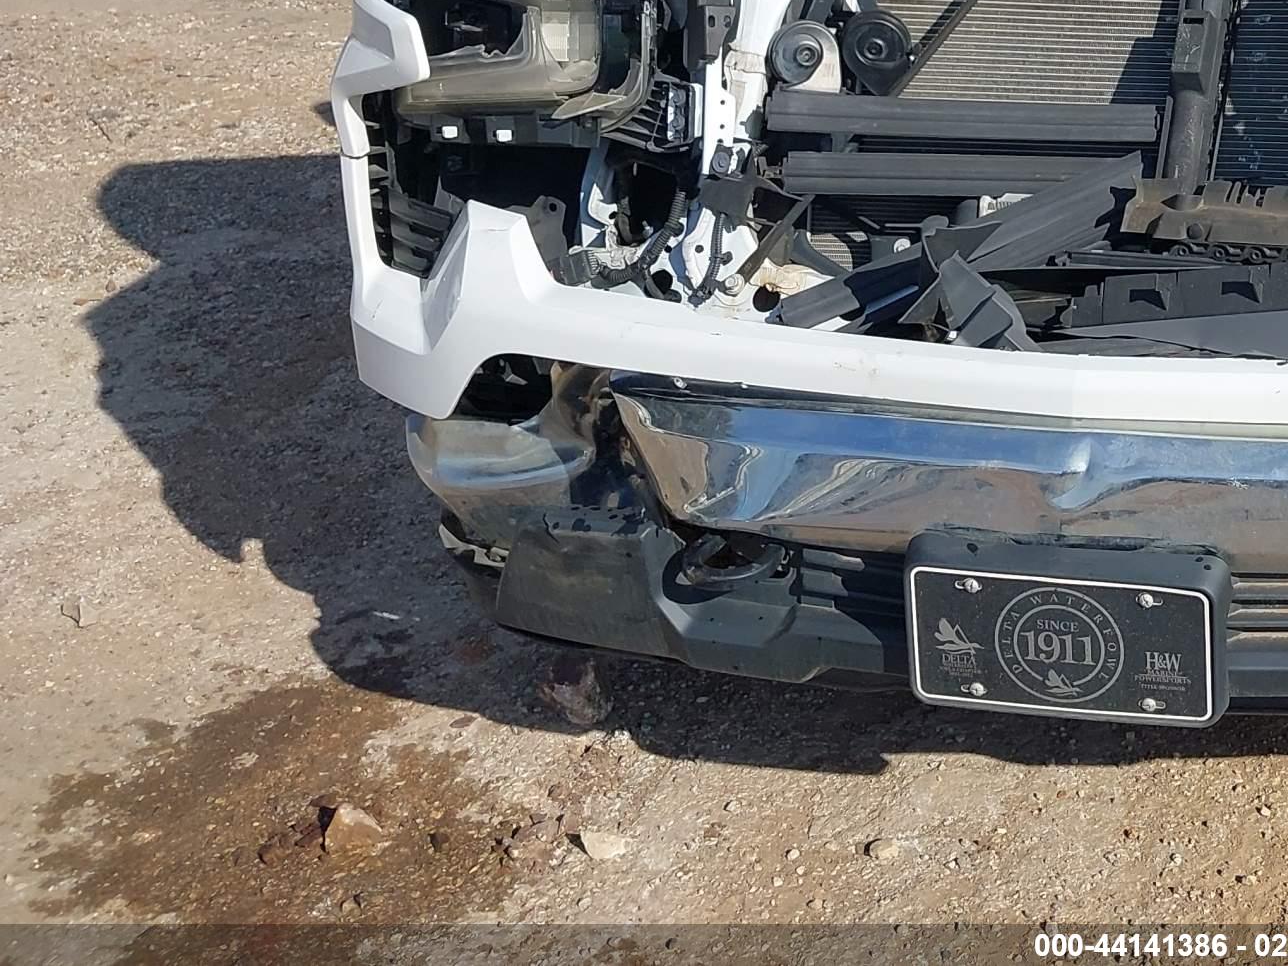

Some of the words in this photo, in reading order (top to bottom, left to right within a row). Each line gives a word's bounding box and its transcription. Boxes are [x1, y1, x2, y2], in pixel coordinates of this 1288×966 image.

[1036, 619, 1079, 632] SINCE
[1002, 611, 1023, 674] DELTA
[1030, 594, 1117, 679] WATERFOWL
[1019, 630, 1096, 666] 1911
[943, 654, 975, 665] DELTA
[1145, 651, 1182, 671] H&W
